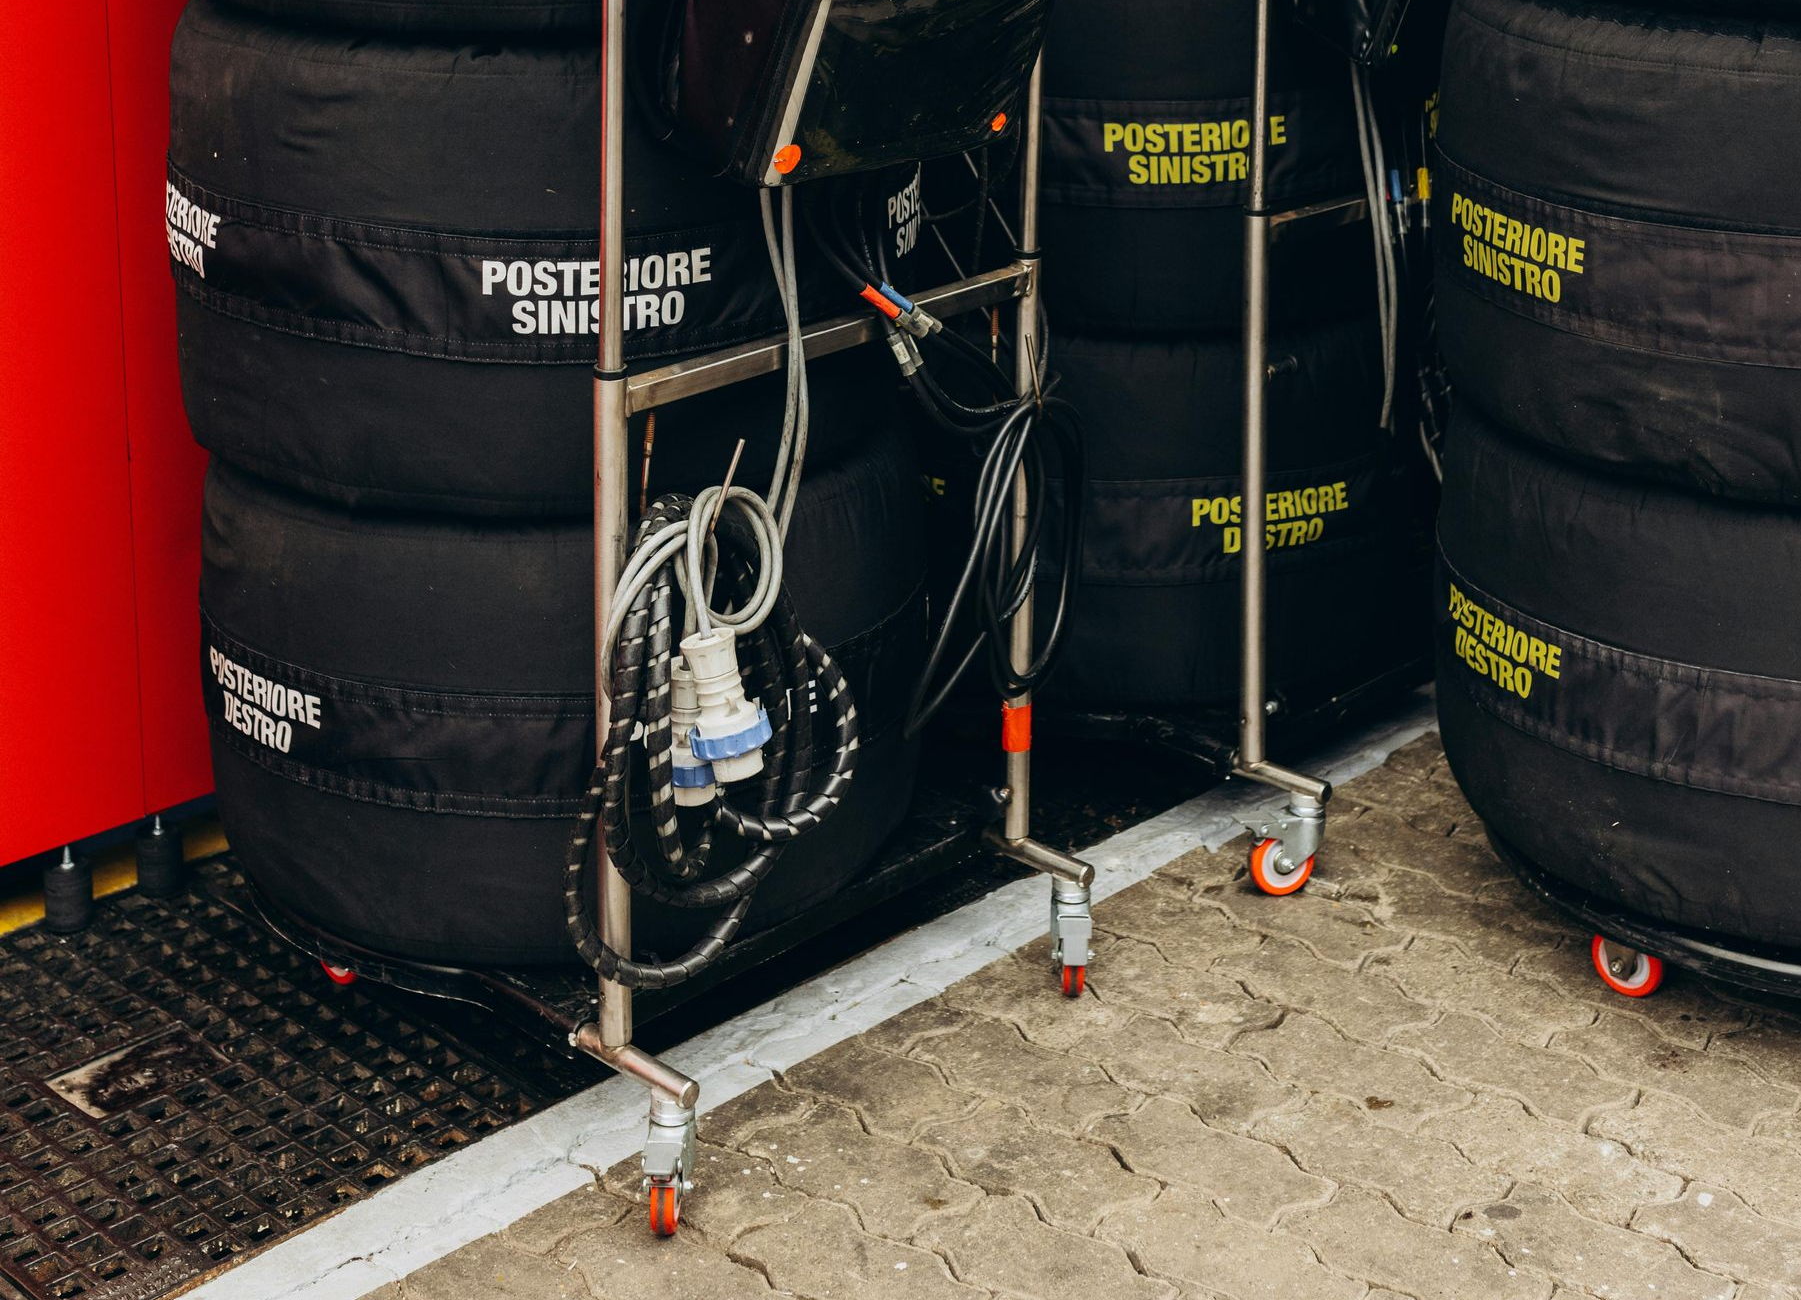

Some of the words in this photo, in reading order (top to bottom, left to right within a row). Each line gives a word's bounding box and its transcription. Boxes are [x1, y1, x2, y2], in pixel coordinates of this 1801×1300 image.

[1103, 116, 1287, 154] POSTERIOE
[1128, 151, 1249, 185] SINISTR
[1451, 192, 1586, 274] POSTERIORE
[482, 247, 712, 297] POSTEIORE
[1463, 234, 1561, 304] SINISTRO
[1192, 480, 1349, 528] POSERIORE
[1223, 516, 1325, 555] DSTRO
[1448, 581, 1562, 680] POSTERIORE
[1455, 626, 1532, 699] DESTRO
[209, 645, 321, 730] POSTERIORE
[223, 690, 292, 754] DESTRO
